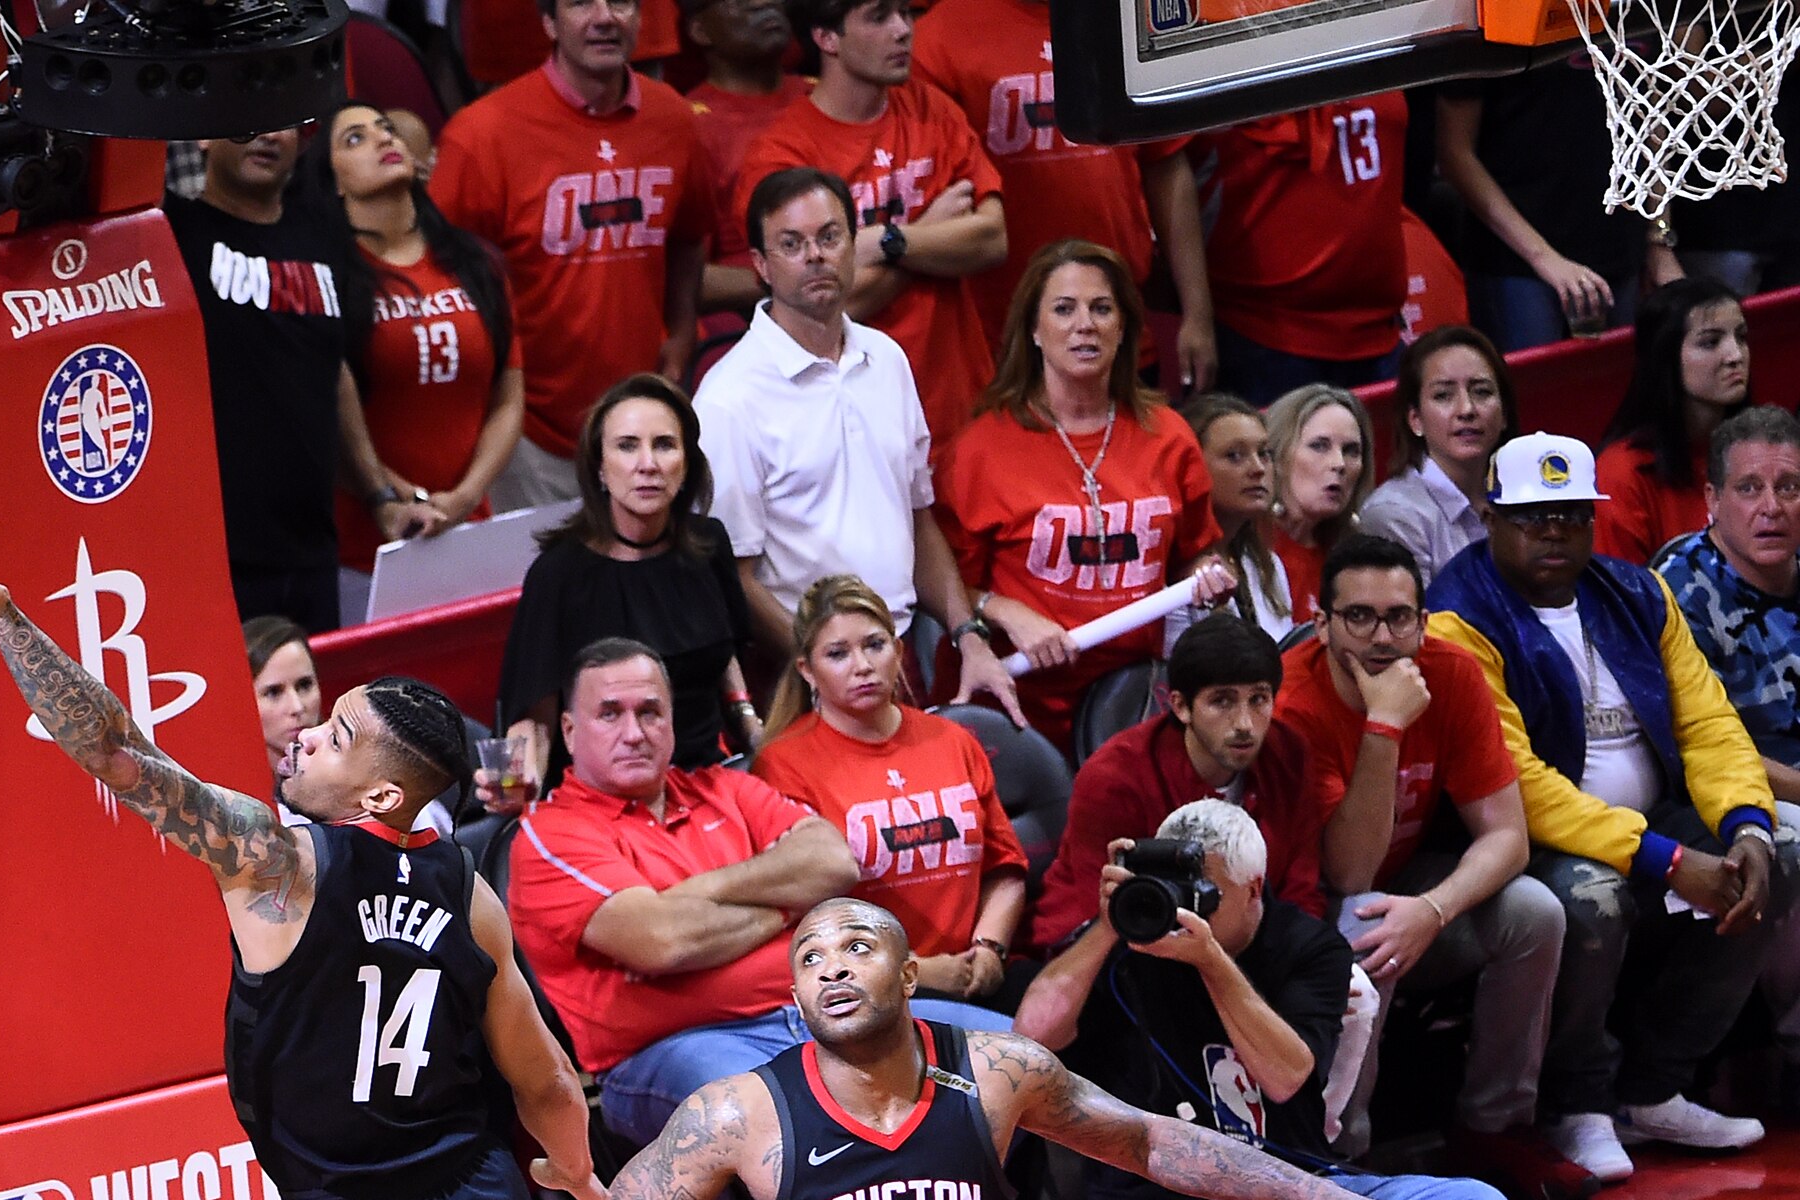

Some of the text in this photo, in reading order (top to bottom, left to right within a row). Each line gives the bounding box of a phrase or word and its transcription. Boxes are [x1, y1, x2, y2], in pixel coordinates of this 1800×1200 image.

[1333, 107, 1381, 185] 13
[541, 164, 674, 256] ONE
[2, 258, 163, 340] SPALDING
[412, 318, 460, 385] 13
[1025, 495, 1172, 589] ONE
[845, 782, 984, 882] ONE
[358, 894, 454, 952] GREEN
[352, 964, 442, 1102] 14
